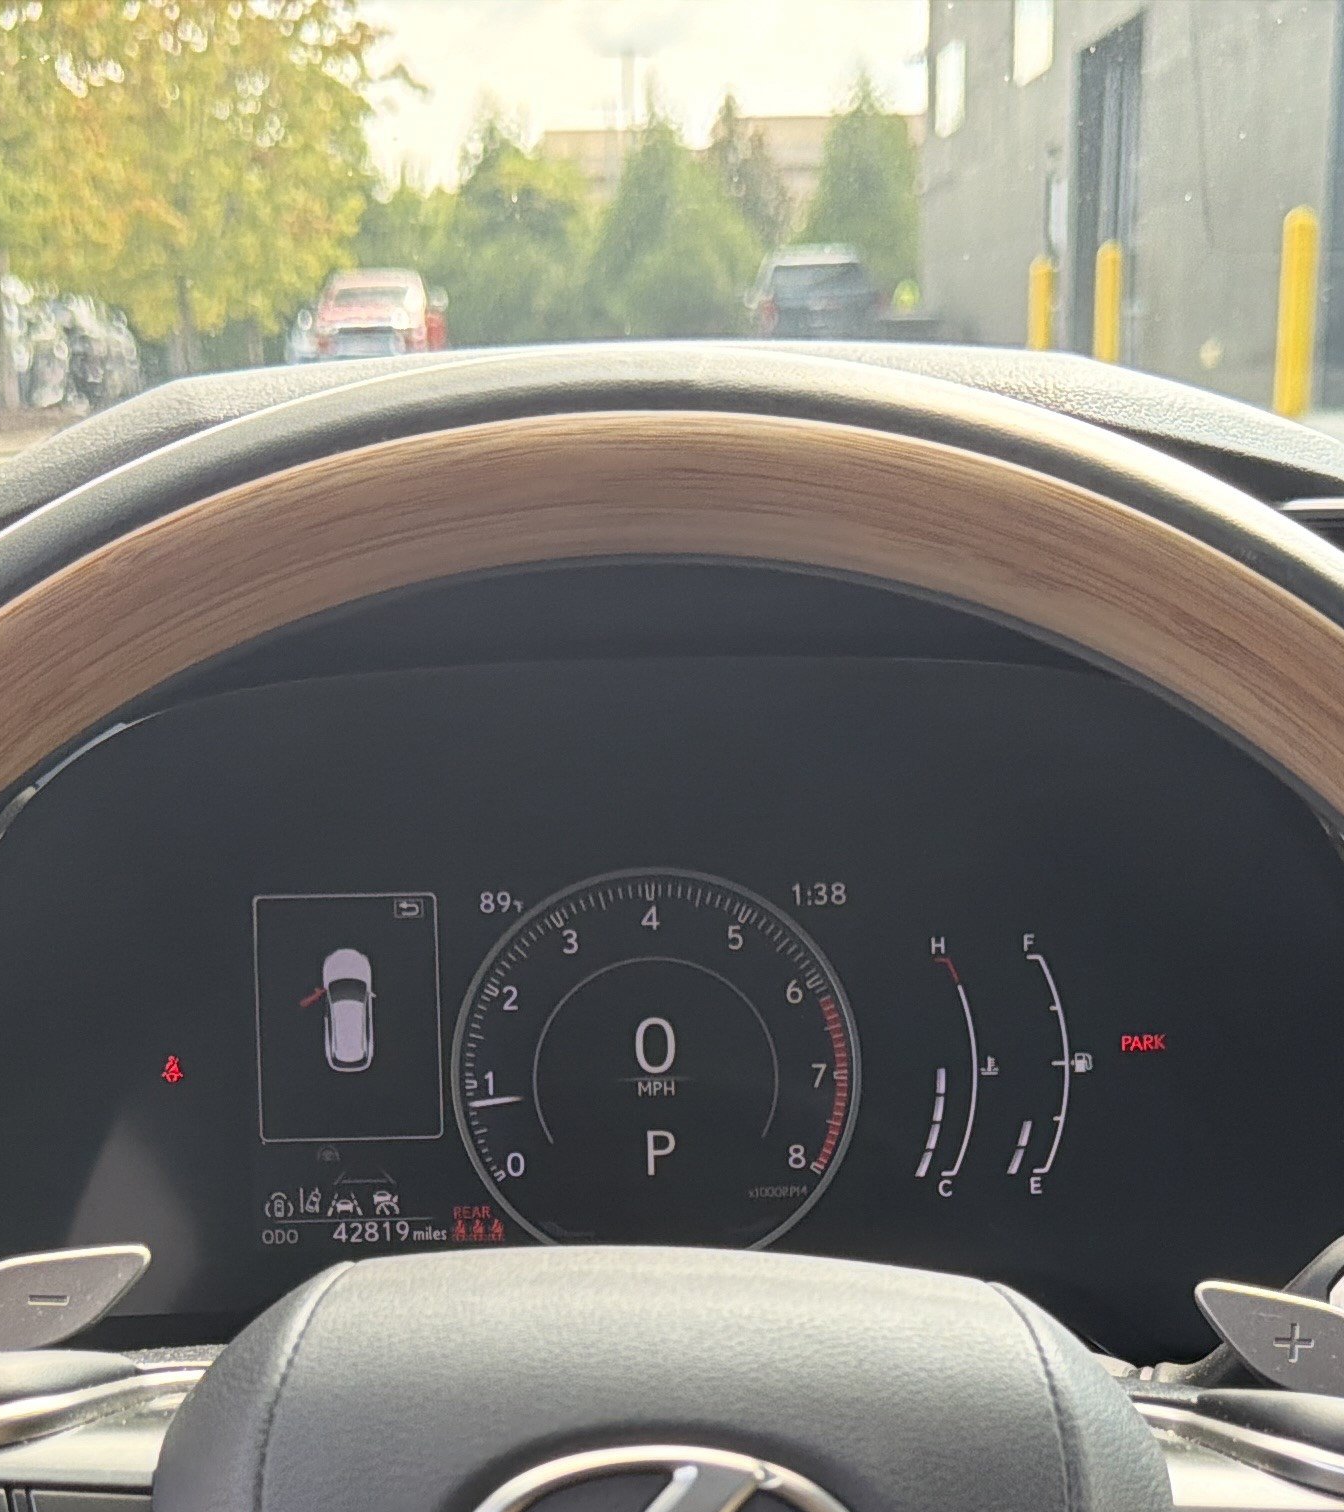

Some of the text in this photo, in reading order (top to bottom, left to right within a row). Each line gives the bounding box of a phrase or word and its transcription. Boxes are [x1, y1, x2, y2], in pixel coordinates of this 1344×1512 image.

[793, 883, 846, 906] 1:38
[641, 908, 659, 930] 4
[563, 931, 579, 954] 3
[727, 927, 743, 950] 5
[930, 936, 946, 954] H
[1023, 933, 1035, 952] F
[503, 987, 519, 1011] 2
[786, 981, 803, 1004] 6
[634, 1017, 676, 1075] 0
[1120, 1033, 1167, 1052] PARK
[484, 1072, 494, 1095] 1
[811, 1065, 825, 1087] 7
[637, 1081, 676, 1097] MPH
[646, 1129, 675, 1176] P
[788, 1144, 806, 1169] 8
[506, 1154, 525, 1176] 0
[938, 1180, 953, 1197] C
[1030, 1177, 1042, 1195] E
[453, 1206, 491, 1220] REAR
[261, 1221, 448, 1244] ODO 42819 miles
